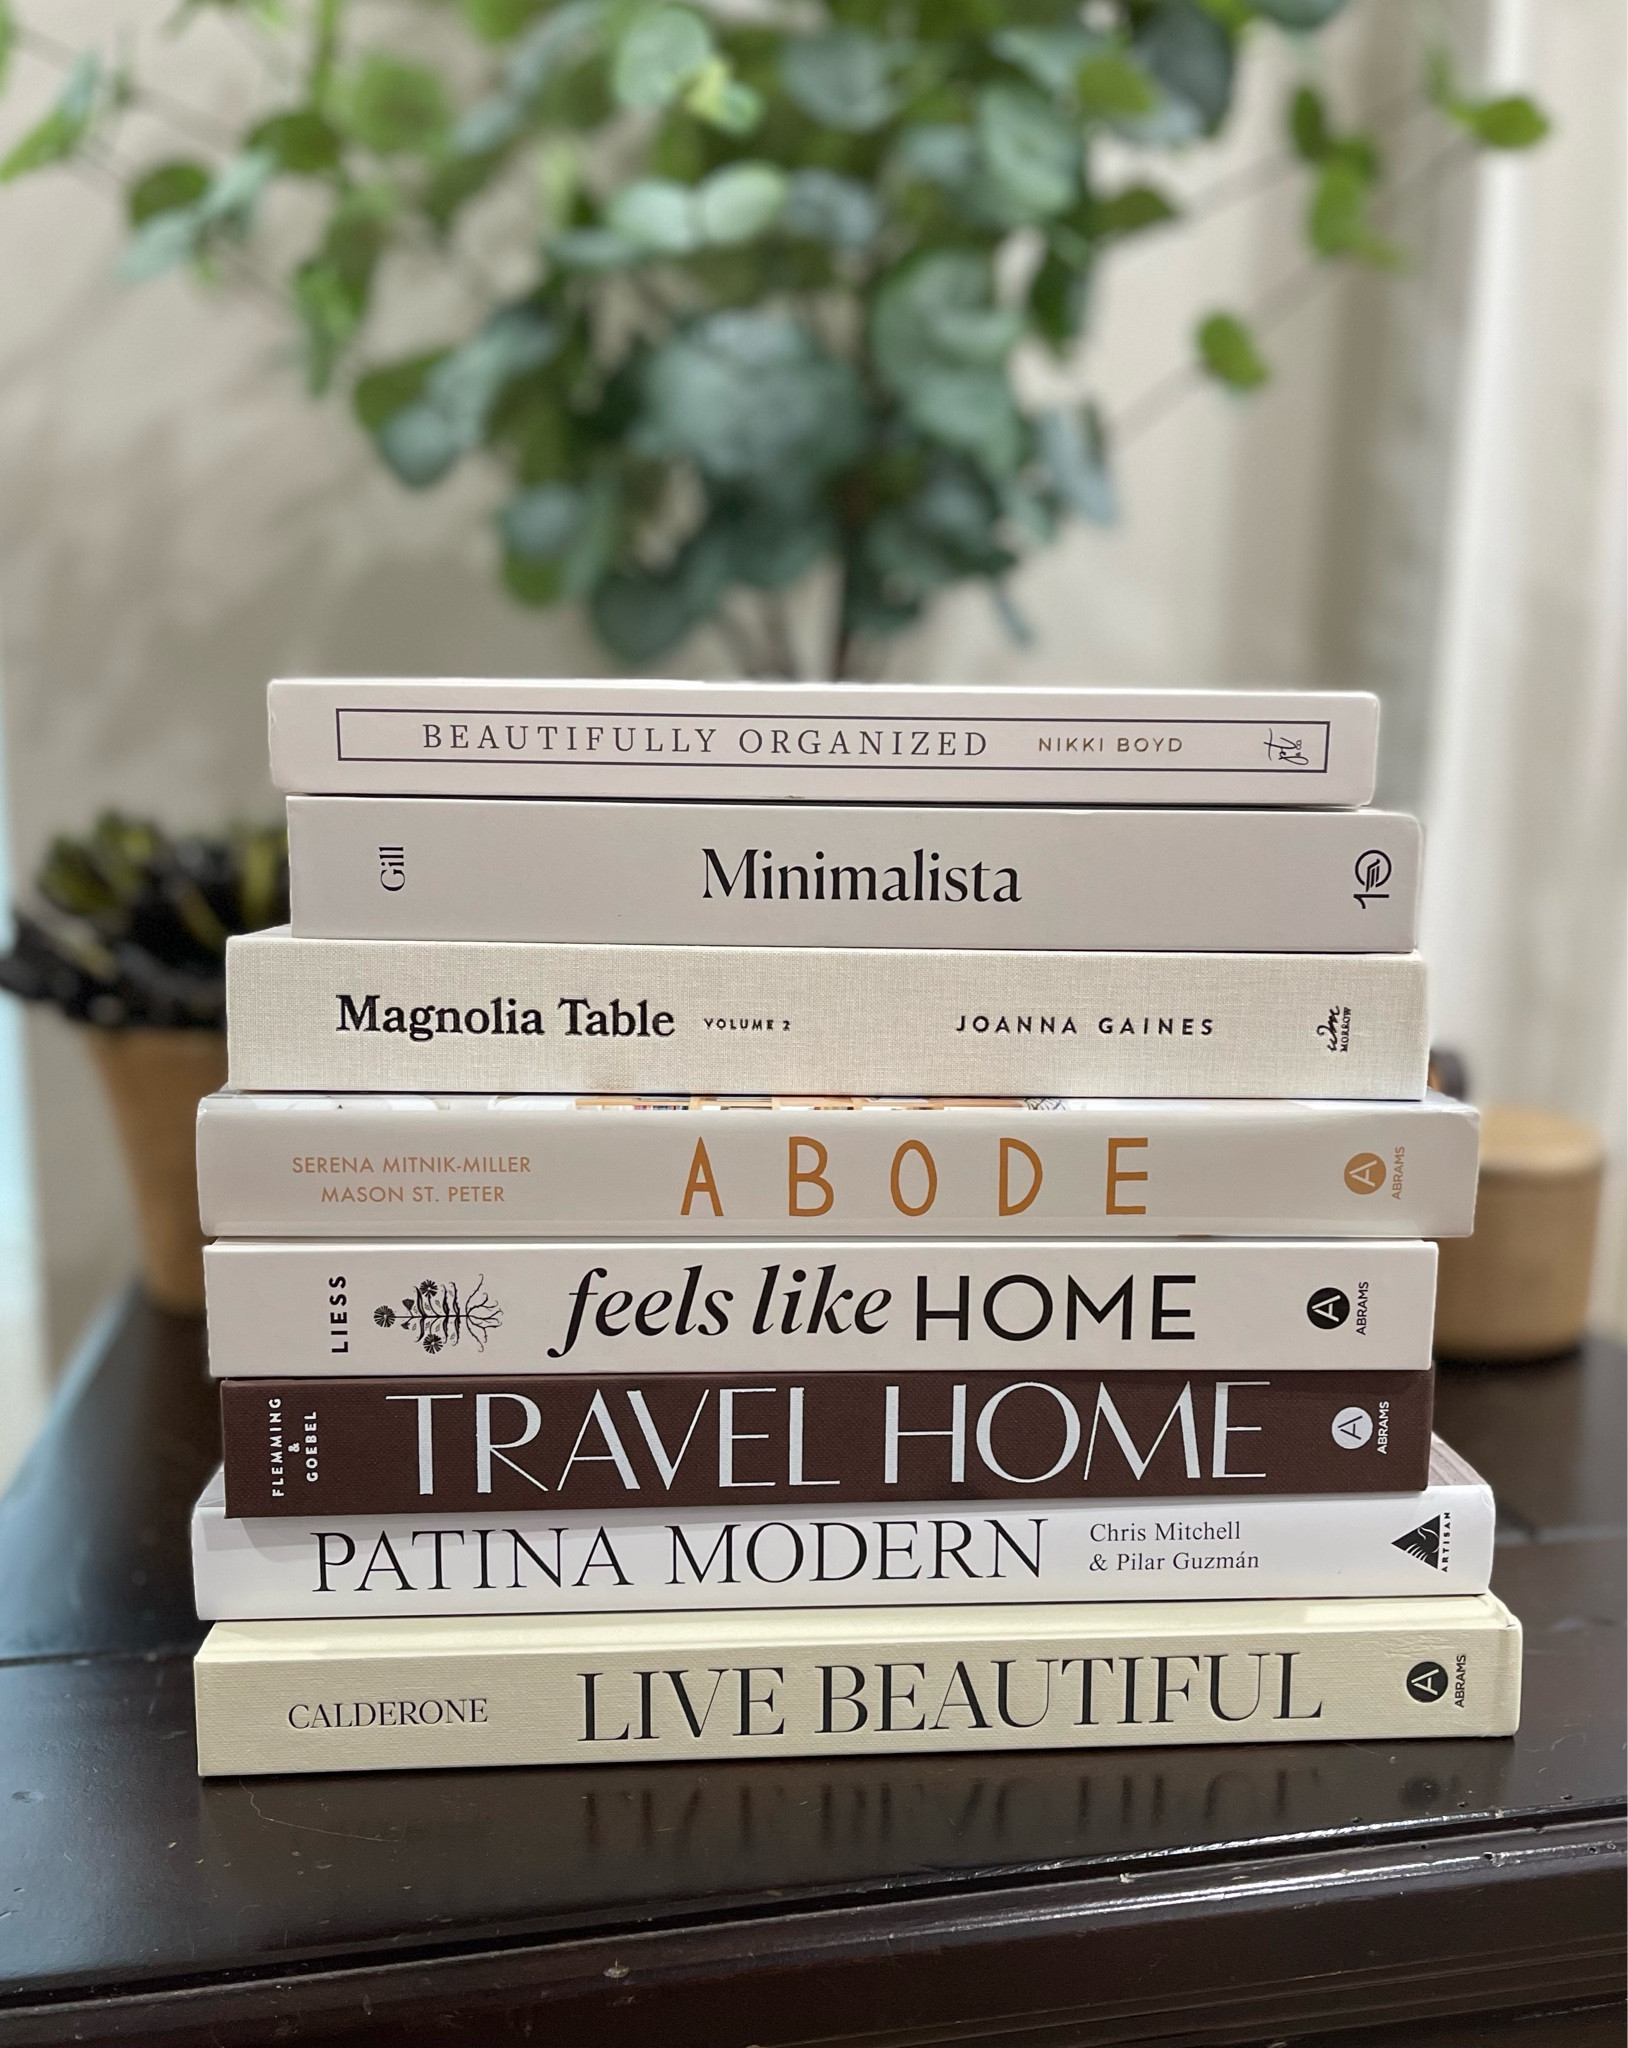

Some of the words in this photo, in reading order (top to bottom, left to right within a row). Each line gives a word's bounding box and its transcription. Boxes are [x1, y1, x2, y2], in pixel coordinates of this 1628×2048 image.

[423, 725, 716, 752] BEAUTIFULLY
[739, 729, 986, 755] ORGANIZED
[1039, 738, 1103, 751] NIKKI
[1117, 738, 1182, 752] BOYD
[379, 847, 405, 891] Gill
[702, 849, 1021, 902] Minimalista
[336, 995, 545, 1041] Magnolia
[558, 998, 675, 1037] Table
[704, 1018, 773, 1030] VOLUME
[783, 1020, 790, 1031] 2
[956, 1016, 1076, 1033] JOANNA
[1099, 1017, 1212, 1035] GAINES
[1340, 1007, 1351, 1052] MORROW
[293, 1157, 374, 1173] SERENA
[383, 1157, 530, 1172] MITNIK-MILLER
[681, 1136, 1148, 1217] ABODE
[1392, 1147, 1405, 1199] ABRAMS
[321, 1187, 402, 1203] MASON
[412, 1187, 440, 1203] ST.
[449, 1186, 504, 1202] PETER
[329, 1276, 348, 1353] LIESS
[547, 1265, 733, 1358] feels
[753, 1264, 891, 1334] like
[917, 1275, 1196, 1341] HOME
[1356, 1282, 1369, 1335] ABRAMS
[268, 1397, 284, 1497] FLEMMING
[288, 1443, 299, 1452] &
[303, 1411, 319, 1482] GOEBEL
[386, 1387, 840, 1494] TRAVEL
[885, 1382, 1270, 1483] HOME
[1377, 1402, 1389, 1454] ABRAMS
[310, 1526, 633, 1591] PATINA
[665, 1519, 1047, 1584] MODERN
[1090, 1523, 1146, 1542] Chris
[1156, 1521, 1239, 1540] Mitchell
[1442, 1513, 1450, 1572] ARTISAN
[1090, 1554, 1107, 1571] &
[1118, 1553, 1165, 1570] Pilar
[1173, 1551, 1258, 1569] Guzmán
[577, 1667, 784, 1741] LIVE
[815, 1652, 1322, 1733] BEAUTIFUL
[1455, 1655, 1466, 1707] ABRAMS
[289, 1699, 487, 1728] CALDERONE
